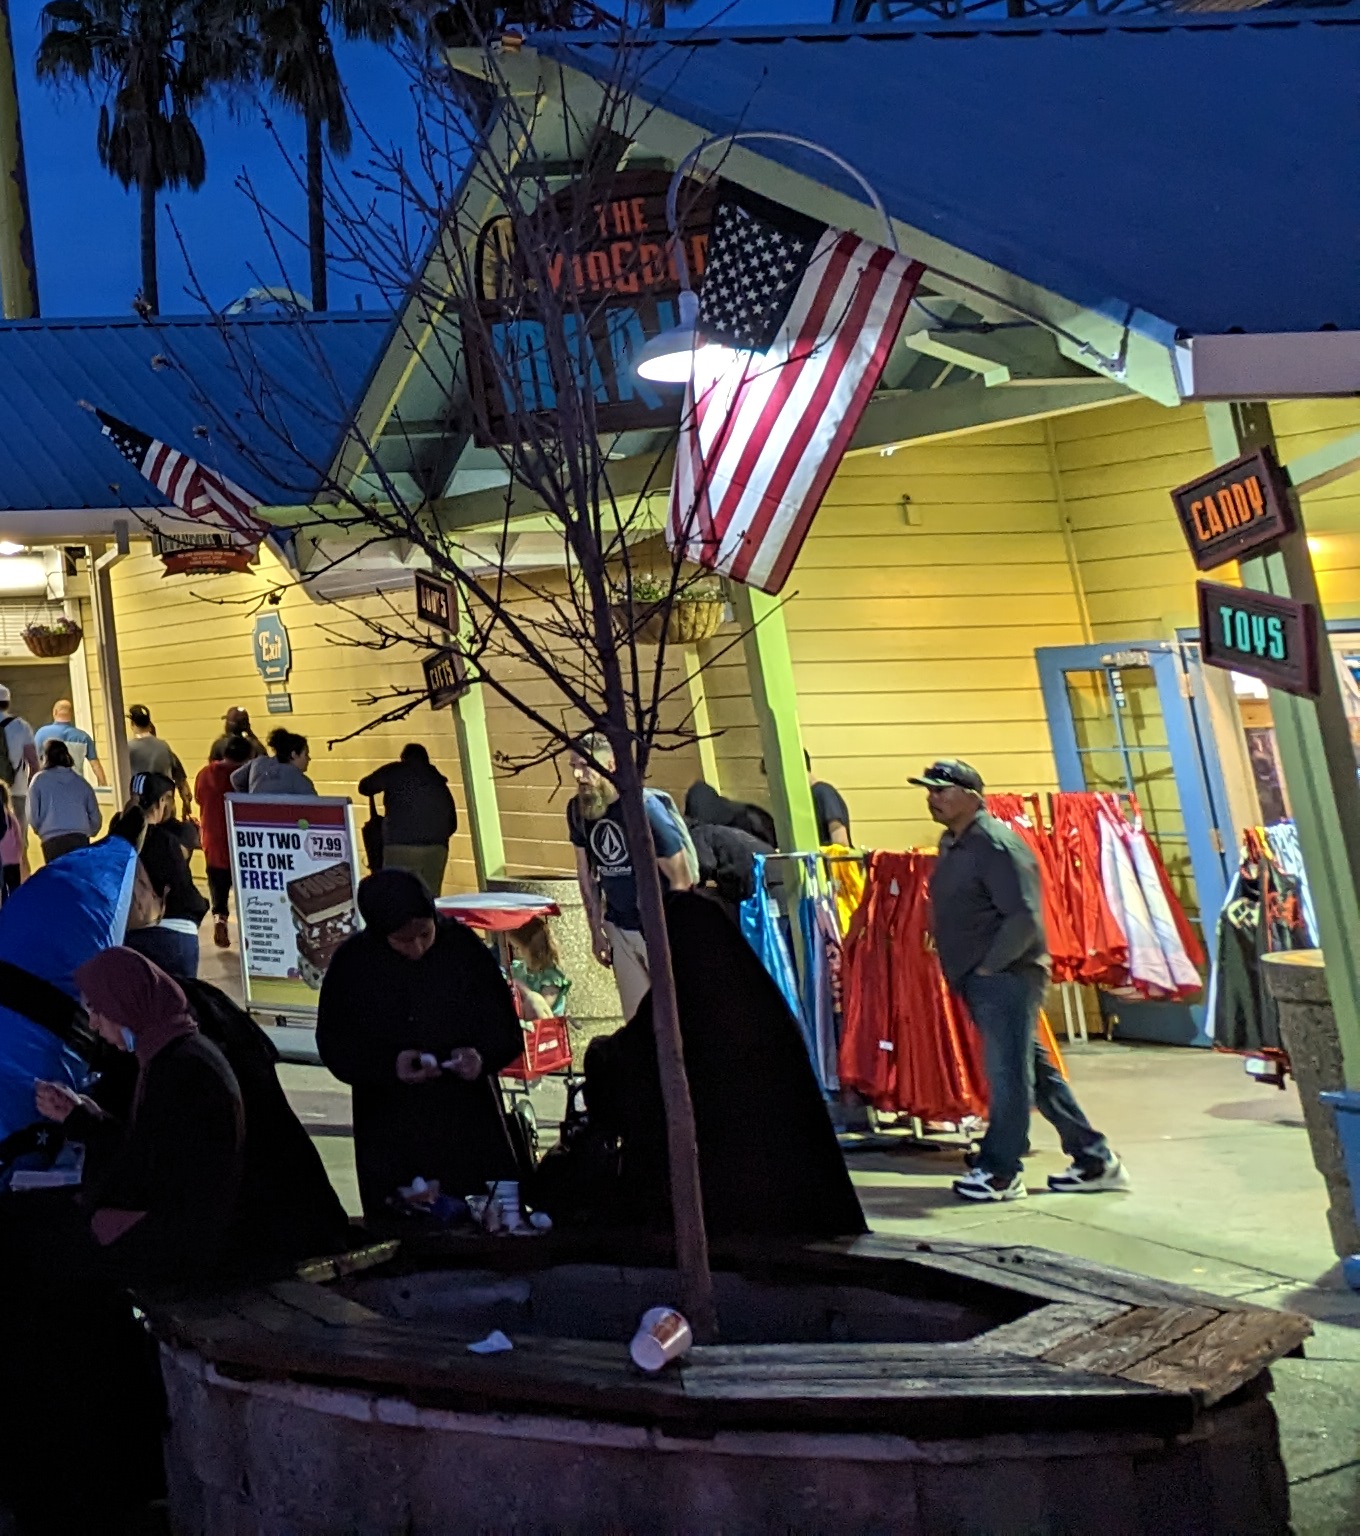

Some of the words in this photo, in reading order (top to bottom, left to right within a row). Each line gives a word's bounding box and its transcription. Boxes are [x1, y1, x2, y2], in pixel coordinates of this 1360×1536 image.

[594, 198, 648, 236] THE
[1190, 476, 1265, 542] CANDY
[258, 631, 282, 662] Exit
[1219, 606, 1285, 660] TOYS
[236, 830, 263, 848] BUY
[266, 832, 301, 851] TWO
[312, 836, 342, 851] $7.99
[238, 852, 264, 870] GET
[267, 854, 295, 870] ONE
[240, 869, 285, 891] FREE!
